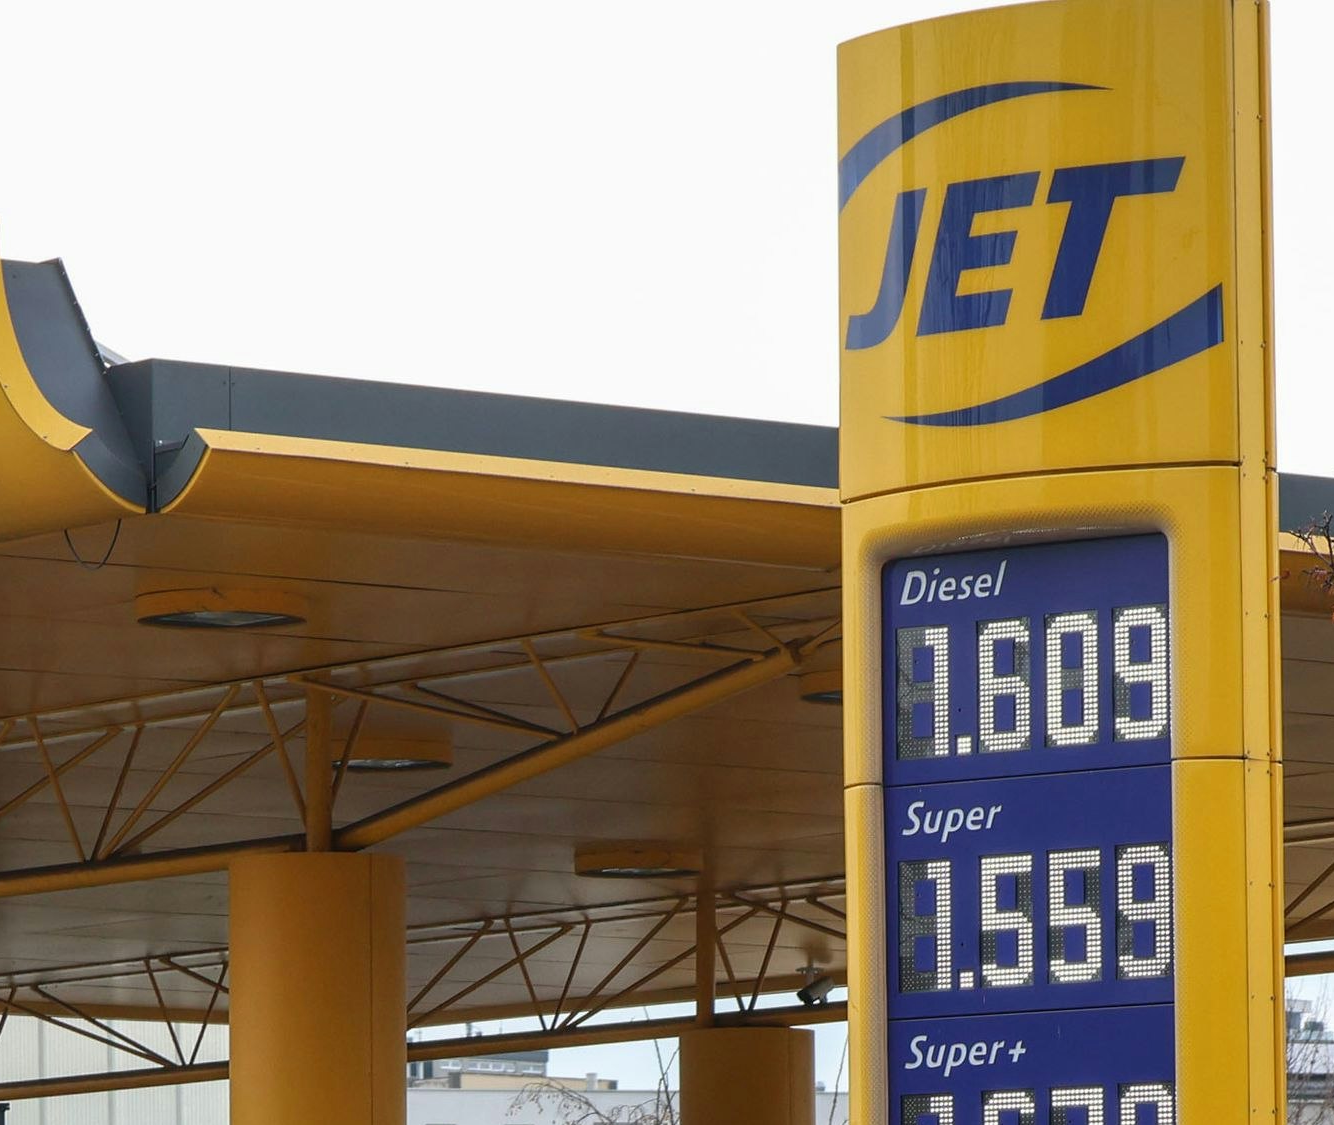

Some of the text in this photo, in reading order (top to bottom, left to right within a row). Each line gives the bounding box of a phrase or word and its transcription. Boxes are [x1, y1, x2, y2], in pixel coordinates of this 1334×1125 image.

[845, 156, 1185, 351] JET
[899, 559, 1008, 606] Diesel
[923, 607, 1168, 757] 1.609
[902, 801, 1002, 843] Super
[925, 845, 1170, 990] 1.559
